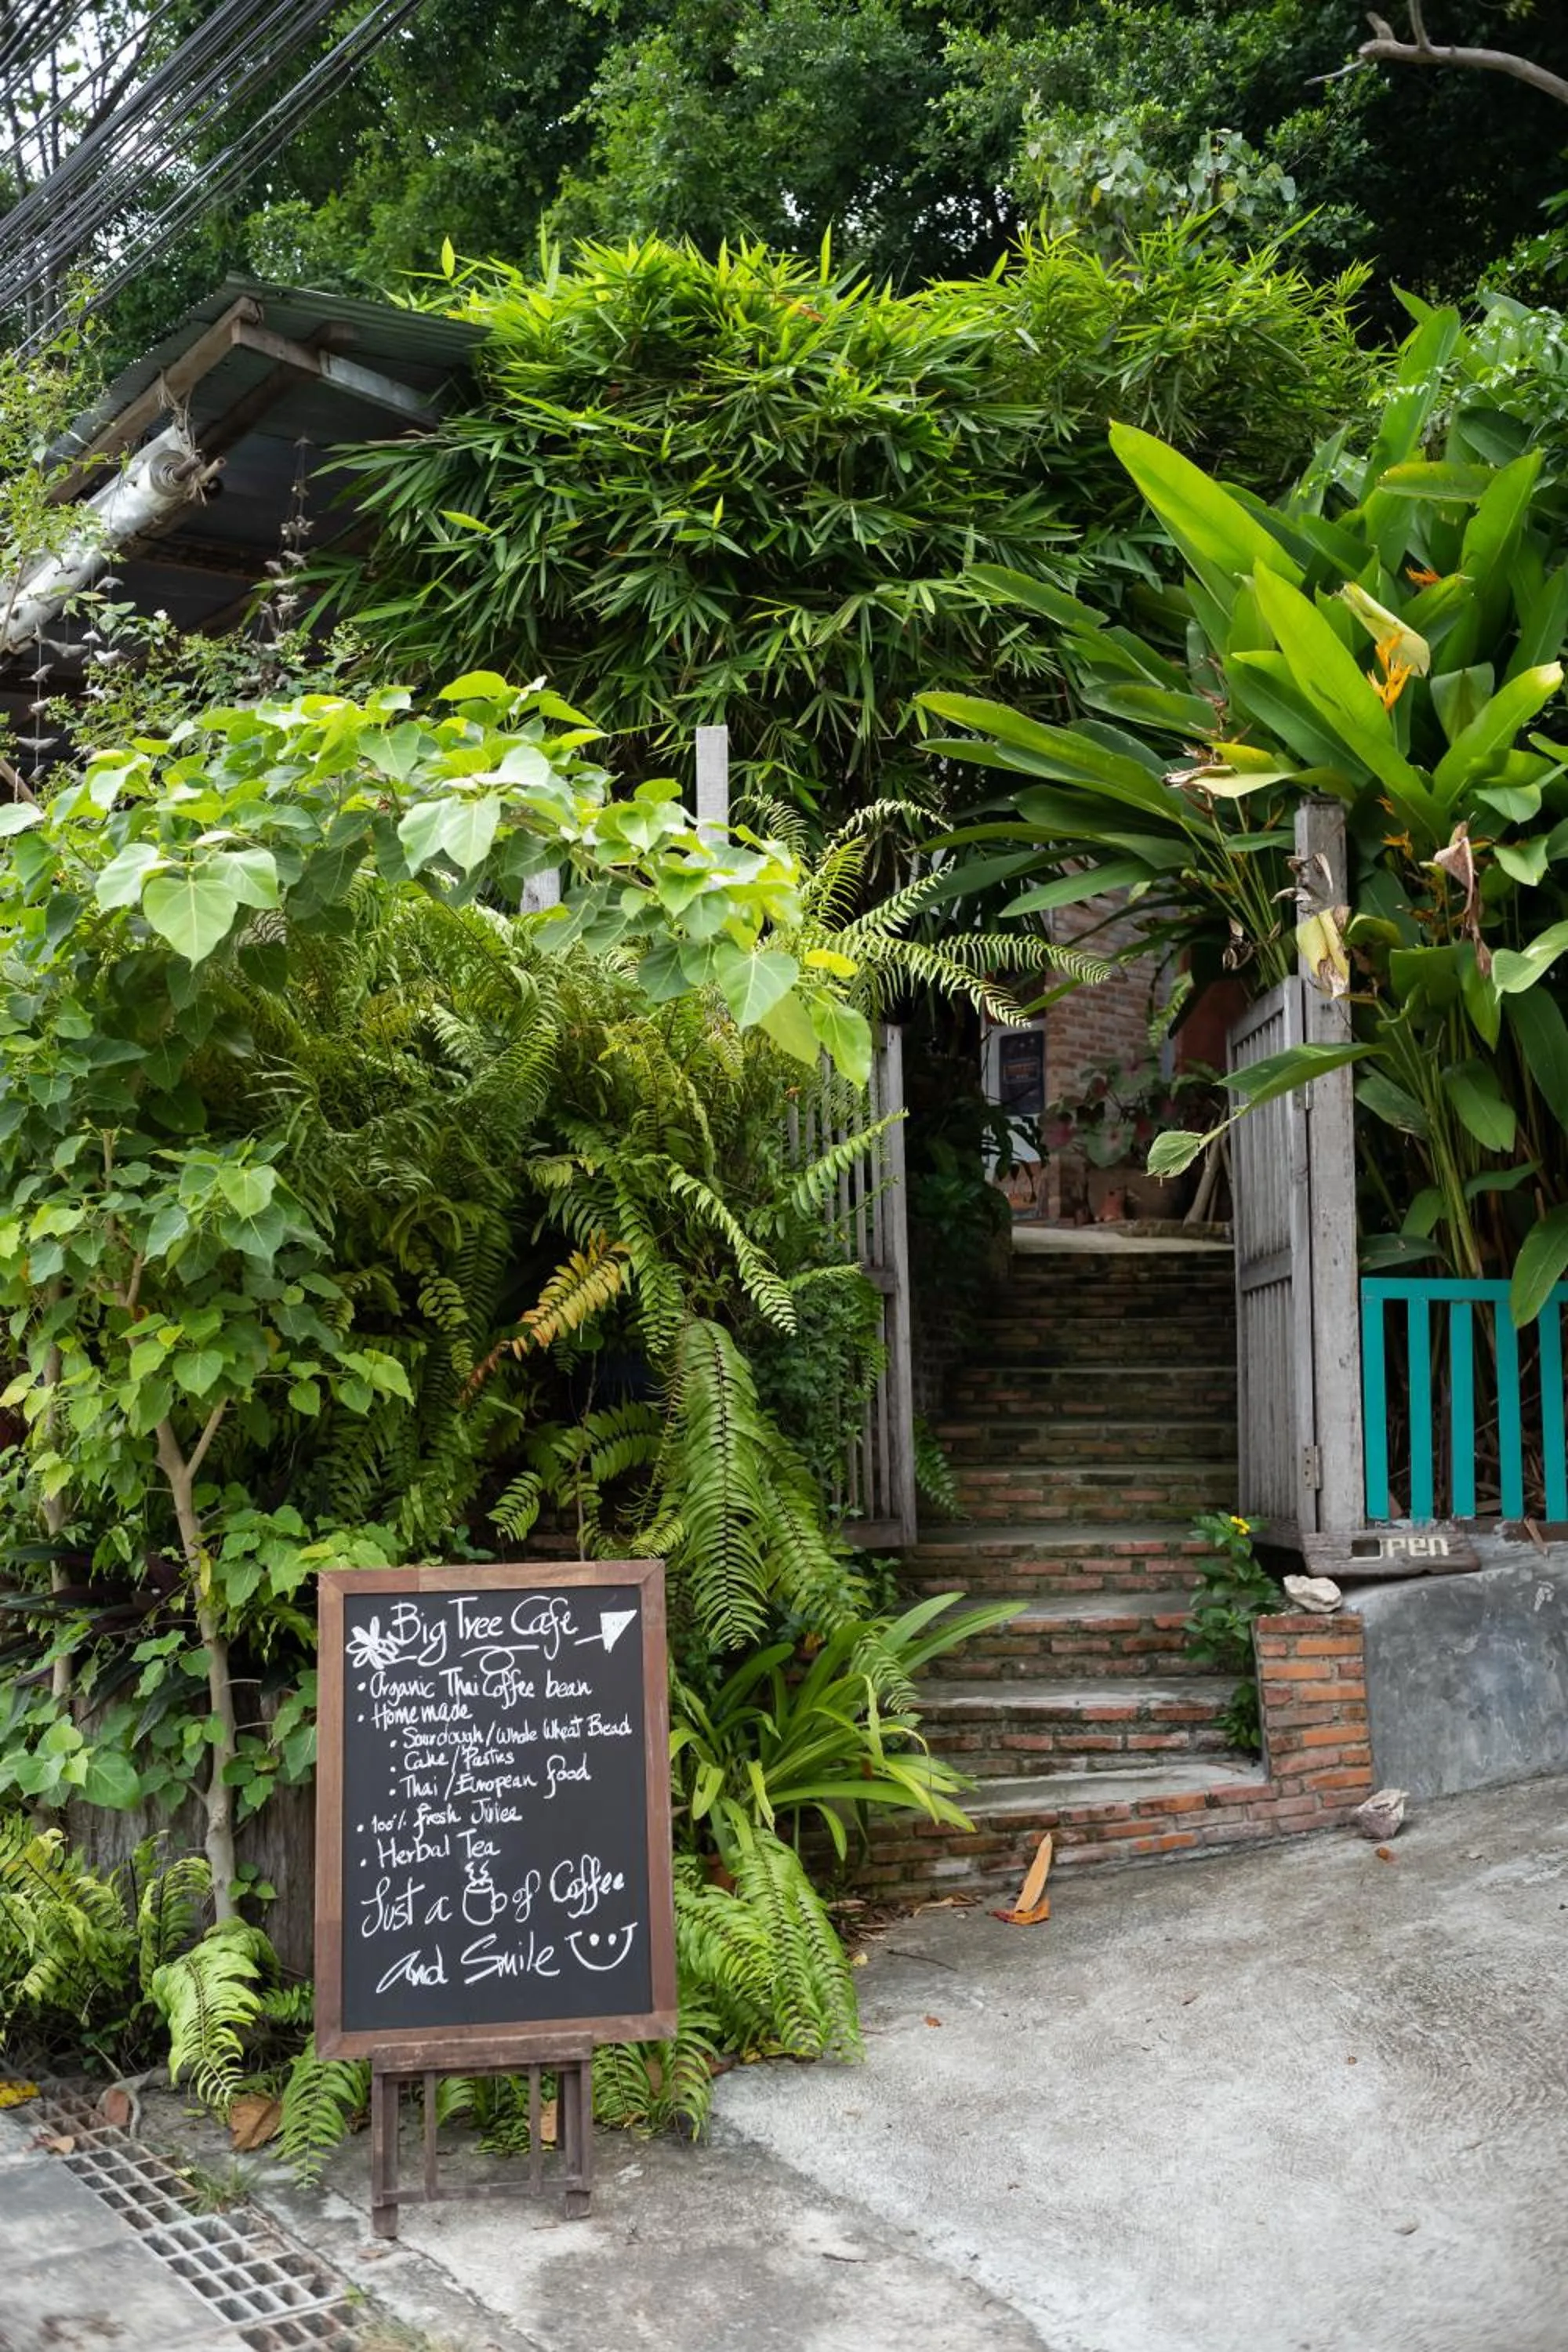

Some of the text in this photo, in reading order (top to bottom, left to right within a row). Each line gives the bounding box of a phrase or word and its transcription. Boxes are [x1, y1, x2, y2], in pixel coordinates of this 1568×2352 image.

[387, 1595, 579, 1667] Big Tree Cafe
[370, 1666, 593, 1710] Organic Thai Coffee bean
[543, 1715, 583, 1742] Wheat
[586, 1712, 633, 1737] Bread
[543, 1752, 592, 1799] food
[372, 1797, 523, 1842] 100% fresh Juice
[377, 1828, 501, 1868] Herbal Tea
[361, 1854, 625, 1938] Just a of Coffee
[460, 1933, 561, 1985] Smile
